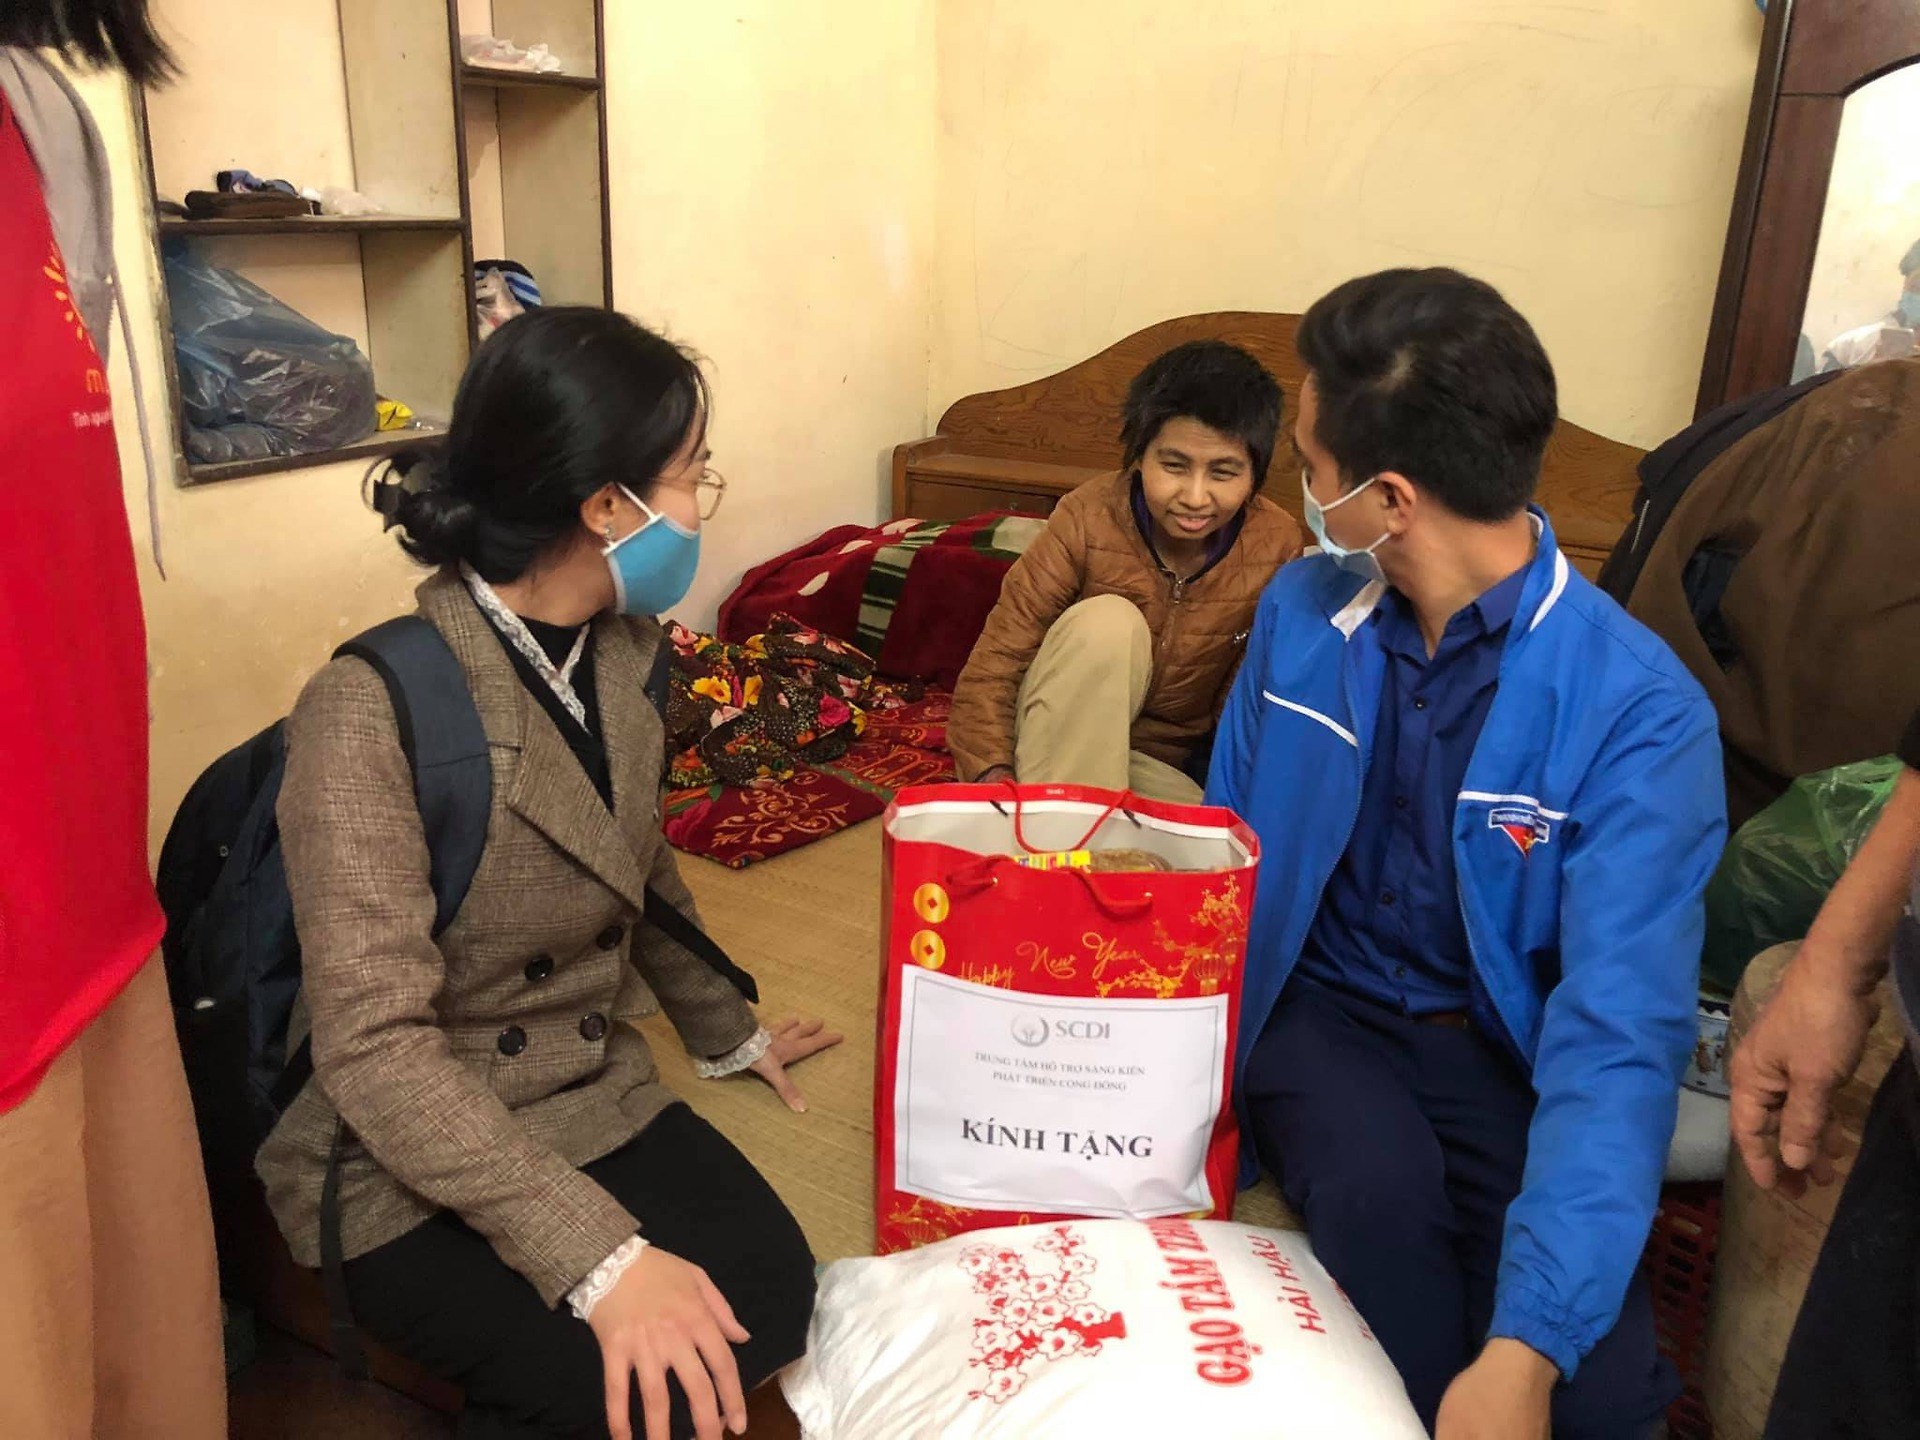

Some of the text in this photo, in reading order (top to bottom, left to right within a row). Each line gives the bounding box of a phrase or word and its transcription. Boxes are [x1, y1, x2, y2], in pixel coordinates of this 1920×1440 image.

[1015, 941, 1077, 980] New
[1082, 931, 1140, 980] Year
[1055, 1020, 1111, 1039] SCDI
[975, 1052, 1011, 1066] TRUNG
[961, 1117, 1153, 1161] KÍNH TẶNG
[1189, 1318, 1263, 1387] GẠO
